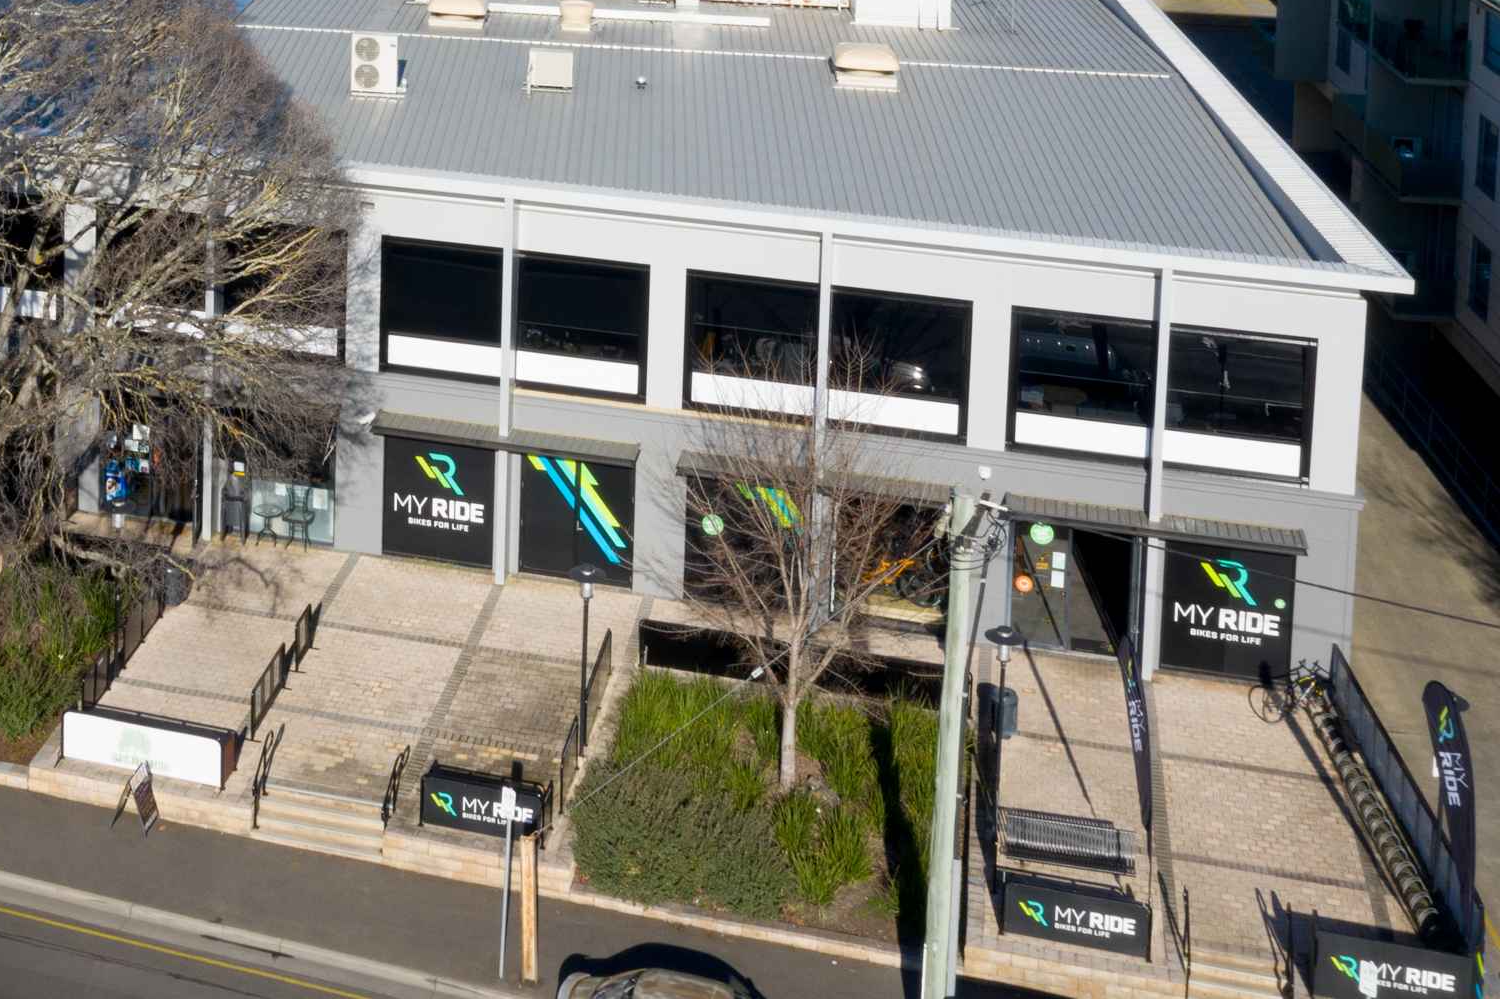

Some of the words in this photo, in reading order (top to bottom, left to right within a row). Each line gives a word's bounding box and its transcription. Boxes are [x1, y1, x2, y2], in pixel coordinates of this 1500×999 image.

[393, 492, 428, 515] MY
[431, 497, 485, 524] RIDE
[408, 517, 432, 527] BIKES
[433, 520, 450, 529] FOR
[451, 523, 469, 532] LIFE
[1173, 601, 1215, 626] MY
[1218, 607, 1281, 637] RIDE
[1190, 628, 1218, 639] BIKES
[1220, 633, 1239, 642] FOR
[1241, 635, 1262, 646] LIFE
[1128, 700, 1143, 753] RIDE
[1438, 751, 1462, 807] RIDE
[1451, 752, 1469, 789] MY
[461, 796, 490, 815] MY
[492, 801, 534, 824] RDE
[461, 812, 482, 821] BIKES
[482, 815, 496, 824] FOR
[497, 818, 508, 826] LIF
[1054, 905, 1086, 926] MY
[1089, 911, 1137, 936] RIDE
[1054, 922, 1076, 933] BIKES
[1077, 926, 1093, 935] FOR
[1094, 929, 1111, 939] LIFE
[1377, 980, 1392, 988] KES
[1393, 981, 1409, 991] FOR
[1410, 985, 1428, 995] LIFE
[1405, 966, 1456, 992] RIDE
